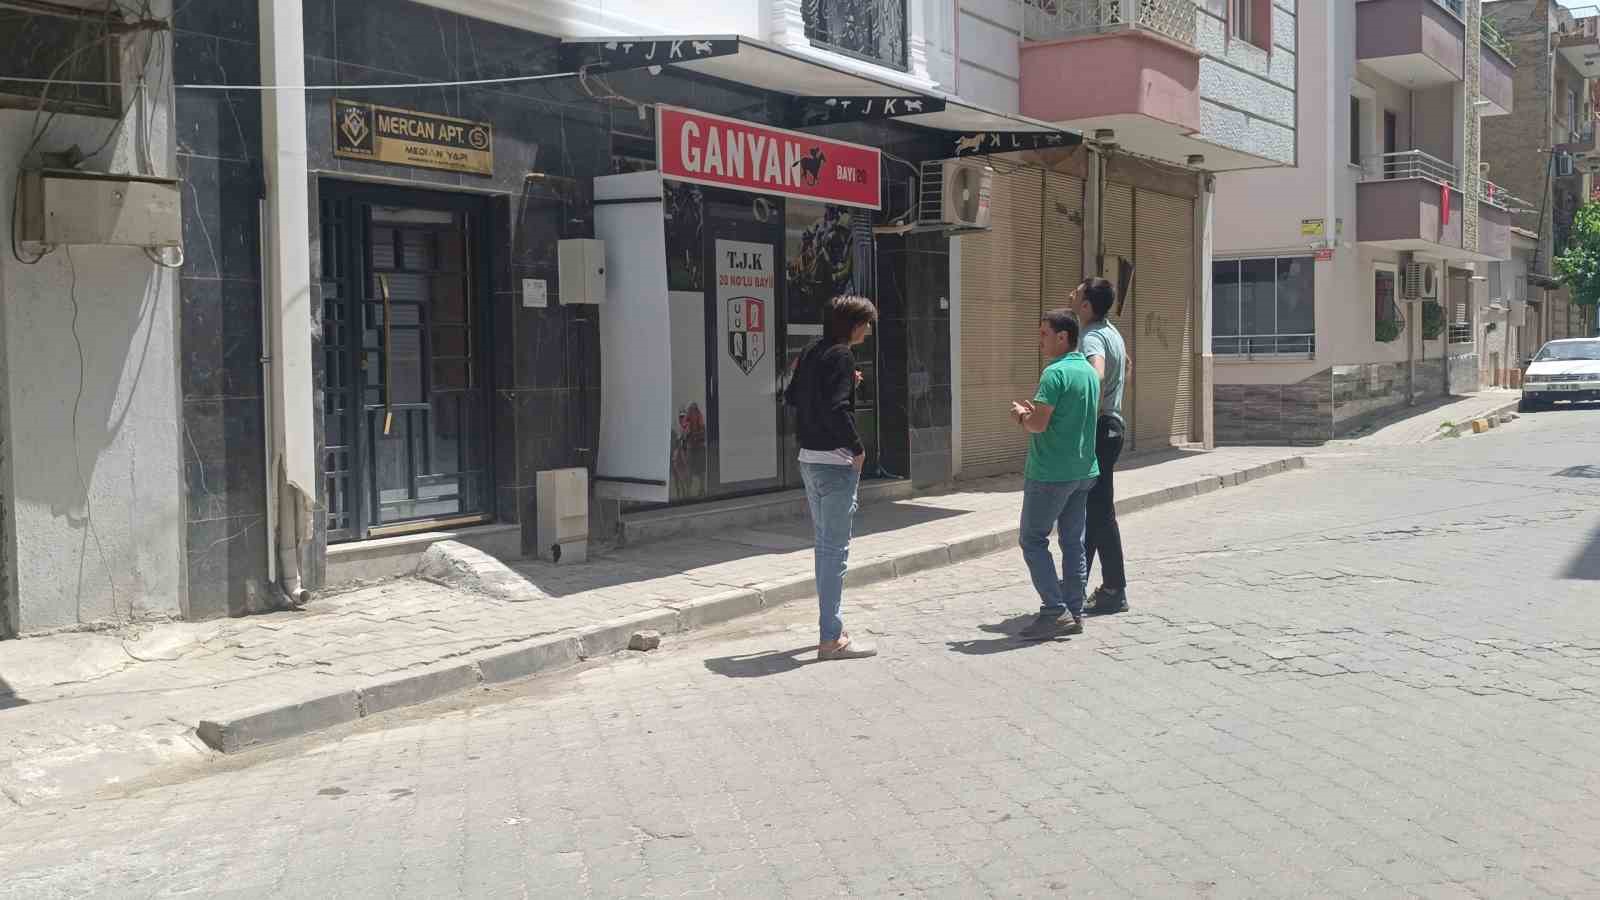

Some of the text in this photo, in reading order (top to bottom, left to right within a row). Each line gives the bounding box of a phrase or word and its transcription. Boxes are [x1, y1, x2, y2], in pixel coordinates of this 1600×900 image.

[378, 114, 465, 144] MERCAN APT.
[680, 120, 800, 188] GANYAN
[727, 251, 762, 270] T.J.K
